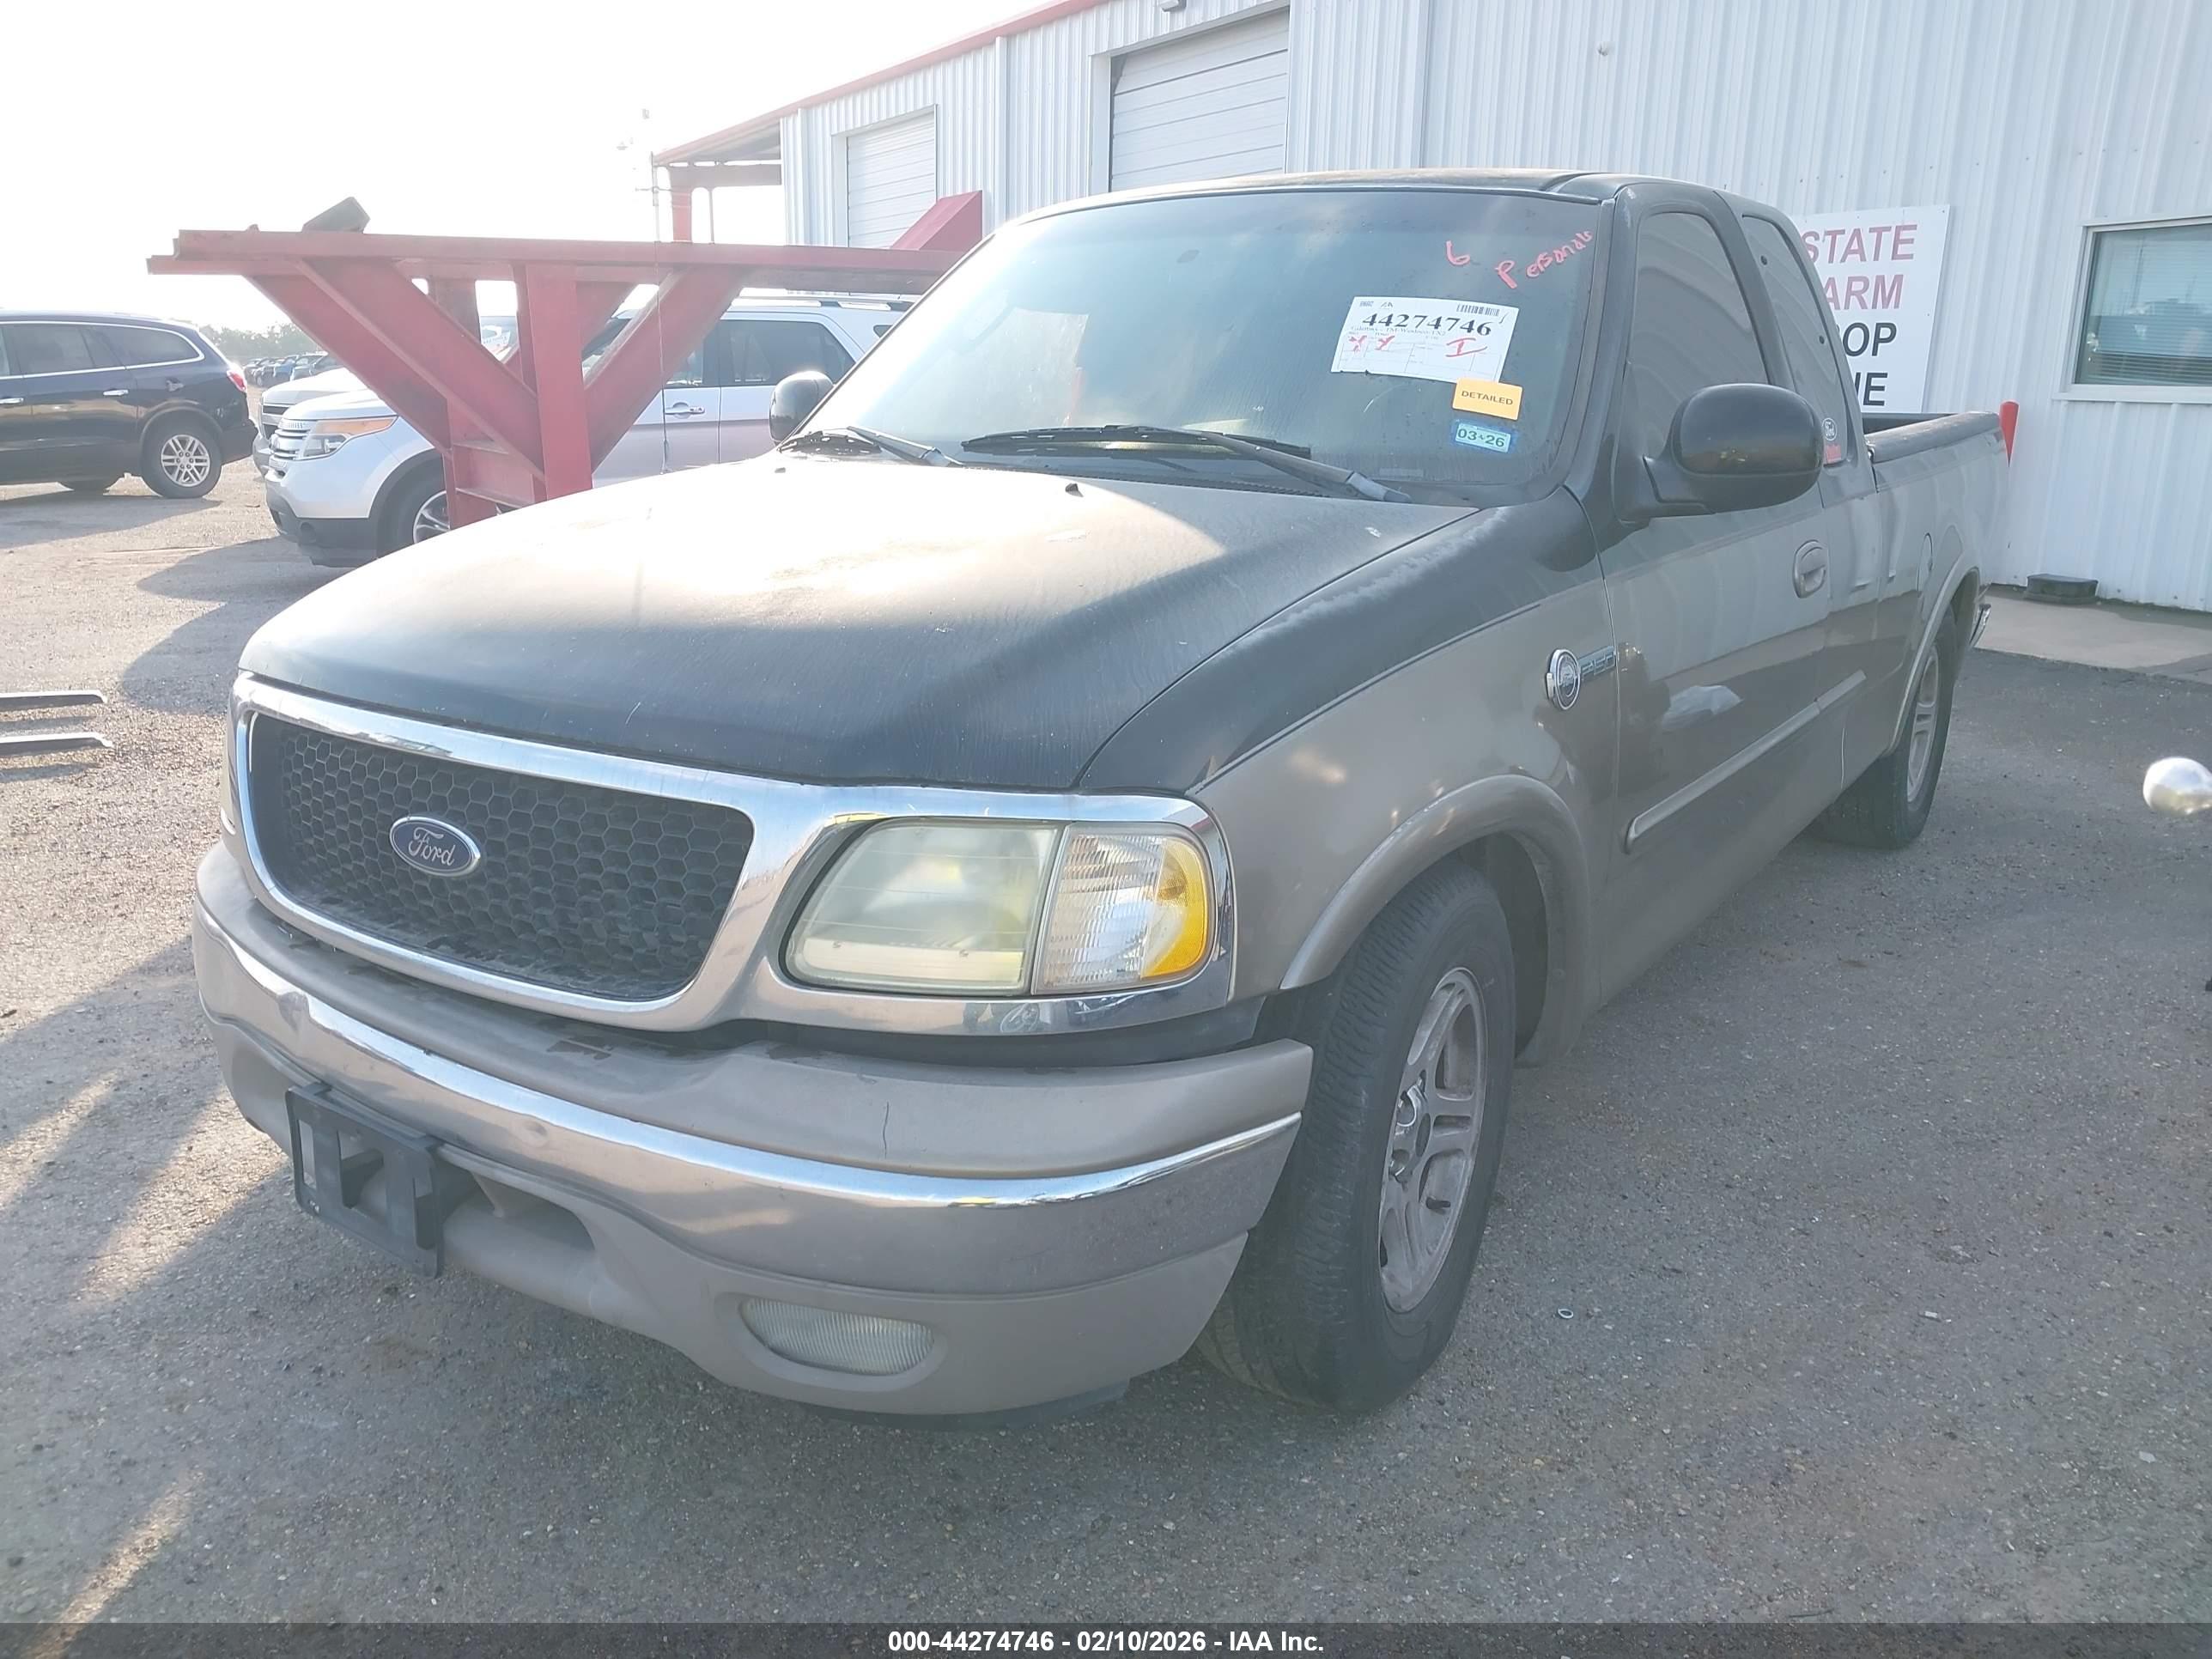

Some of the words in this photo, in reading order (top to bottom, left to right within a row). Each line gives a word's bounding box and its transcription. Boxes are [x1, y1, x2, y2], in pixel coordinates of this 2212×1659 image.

[1801, 224, 1917, 264] STATE
[1362, 313, 1492, 336] 44274746
[1836, 322, 1897, 356] OP
[1462, 391, 1513, 405] DETAILED
[409, 827, 456, 866] Ford
